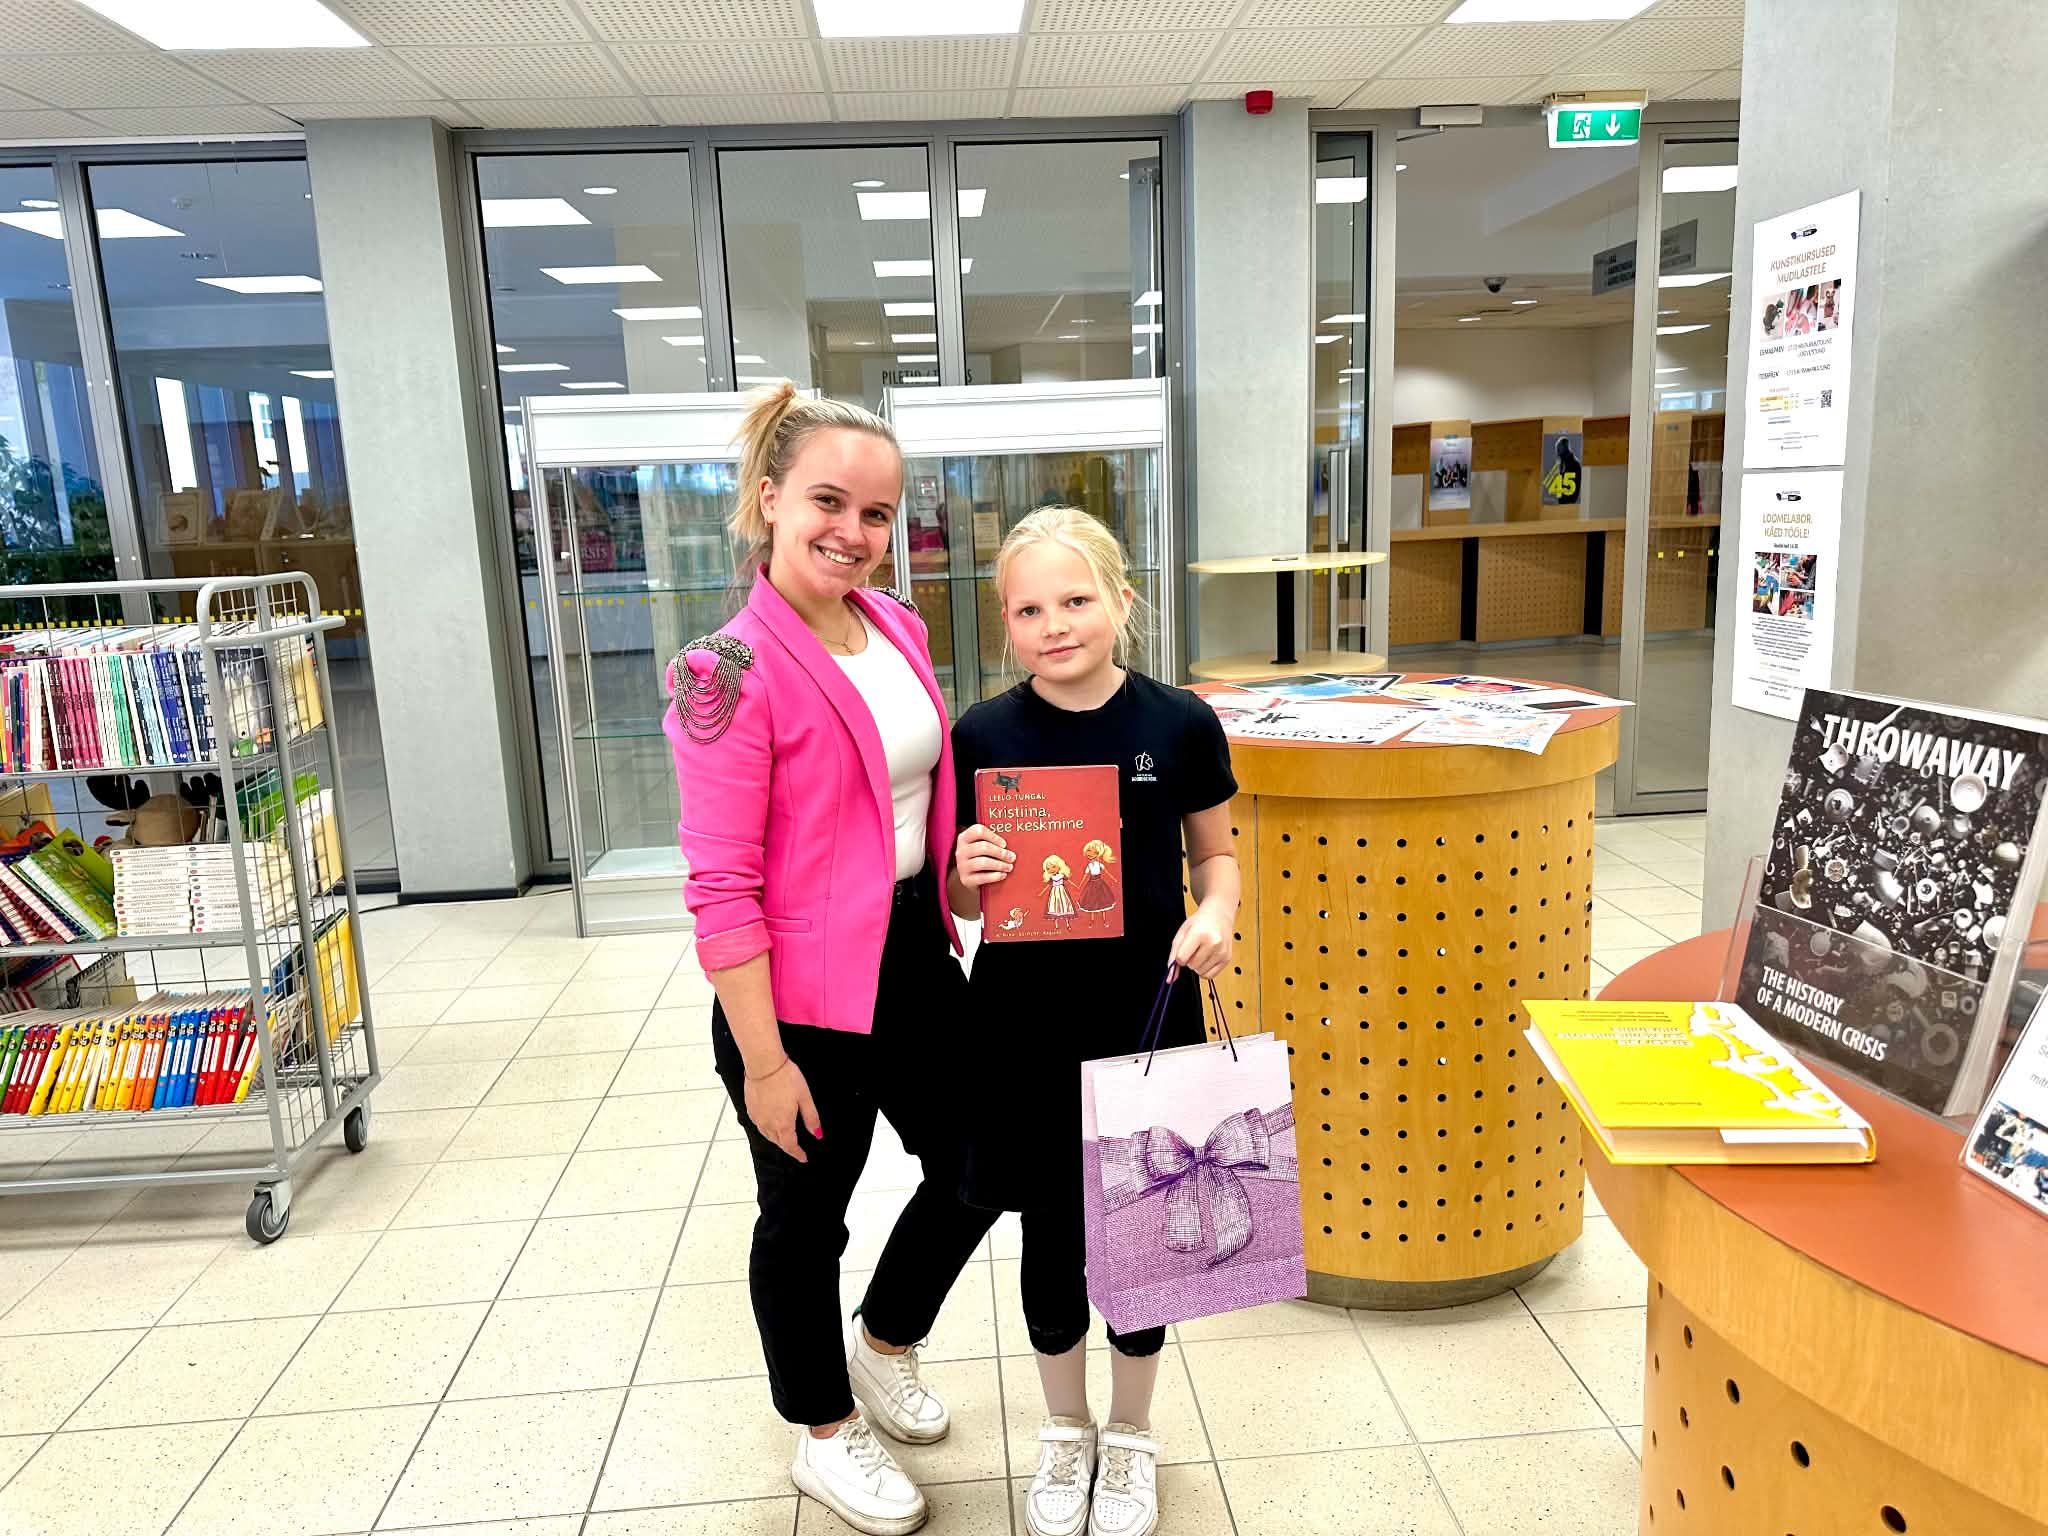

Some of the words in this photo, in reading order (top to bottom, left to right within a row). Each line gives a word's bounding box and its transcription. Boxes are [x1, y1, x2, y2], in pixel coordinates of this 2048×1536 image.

[1770, 244, 1836, 271] KUNSTIKURSUSED
[1777, 262, 1827, 283] MUDILASTELE
[1548, 472, 1576, 498] 45
[1822, 713, 2026, 791] THROWAWAY
[989, 794, 1012, 802] LEELO
[1014, 793, 1046, 801] TUNGAL
[989, 805, 1051, 819] Kristiina,
[989, 822, 1013, 833] see
[1016, 818, 1084, 833] keskmine
[1763, 965, 1788, 991] THE
[1786, 976, 1845, 1017] HISTORY
[1757, 986, 1774, 1007] OF
[1772, 995, 1782, 1013] A
[1783, 999, 1842, 1041] MODERN
[1842, 1027, 1888, 1062] CRISIS
